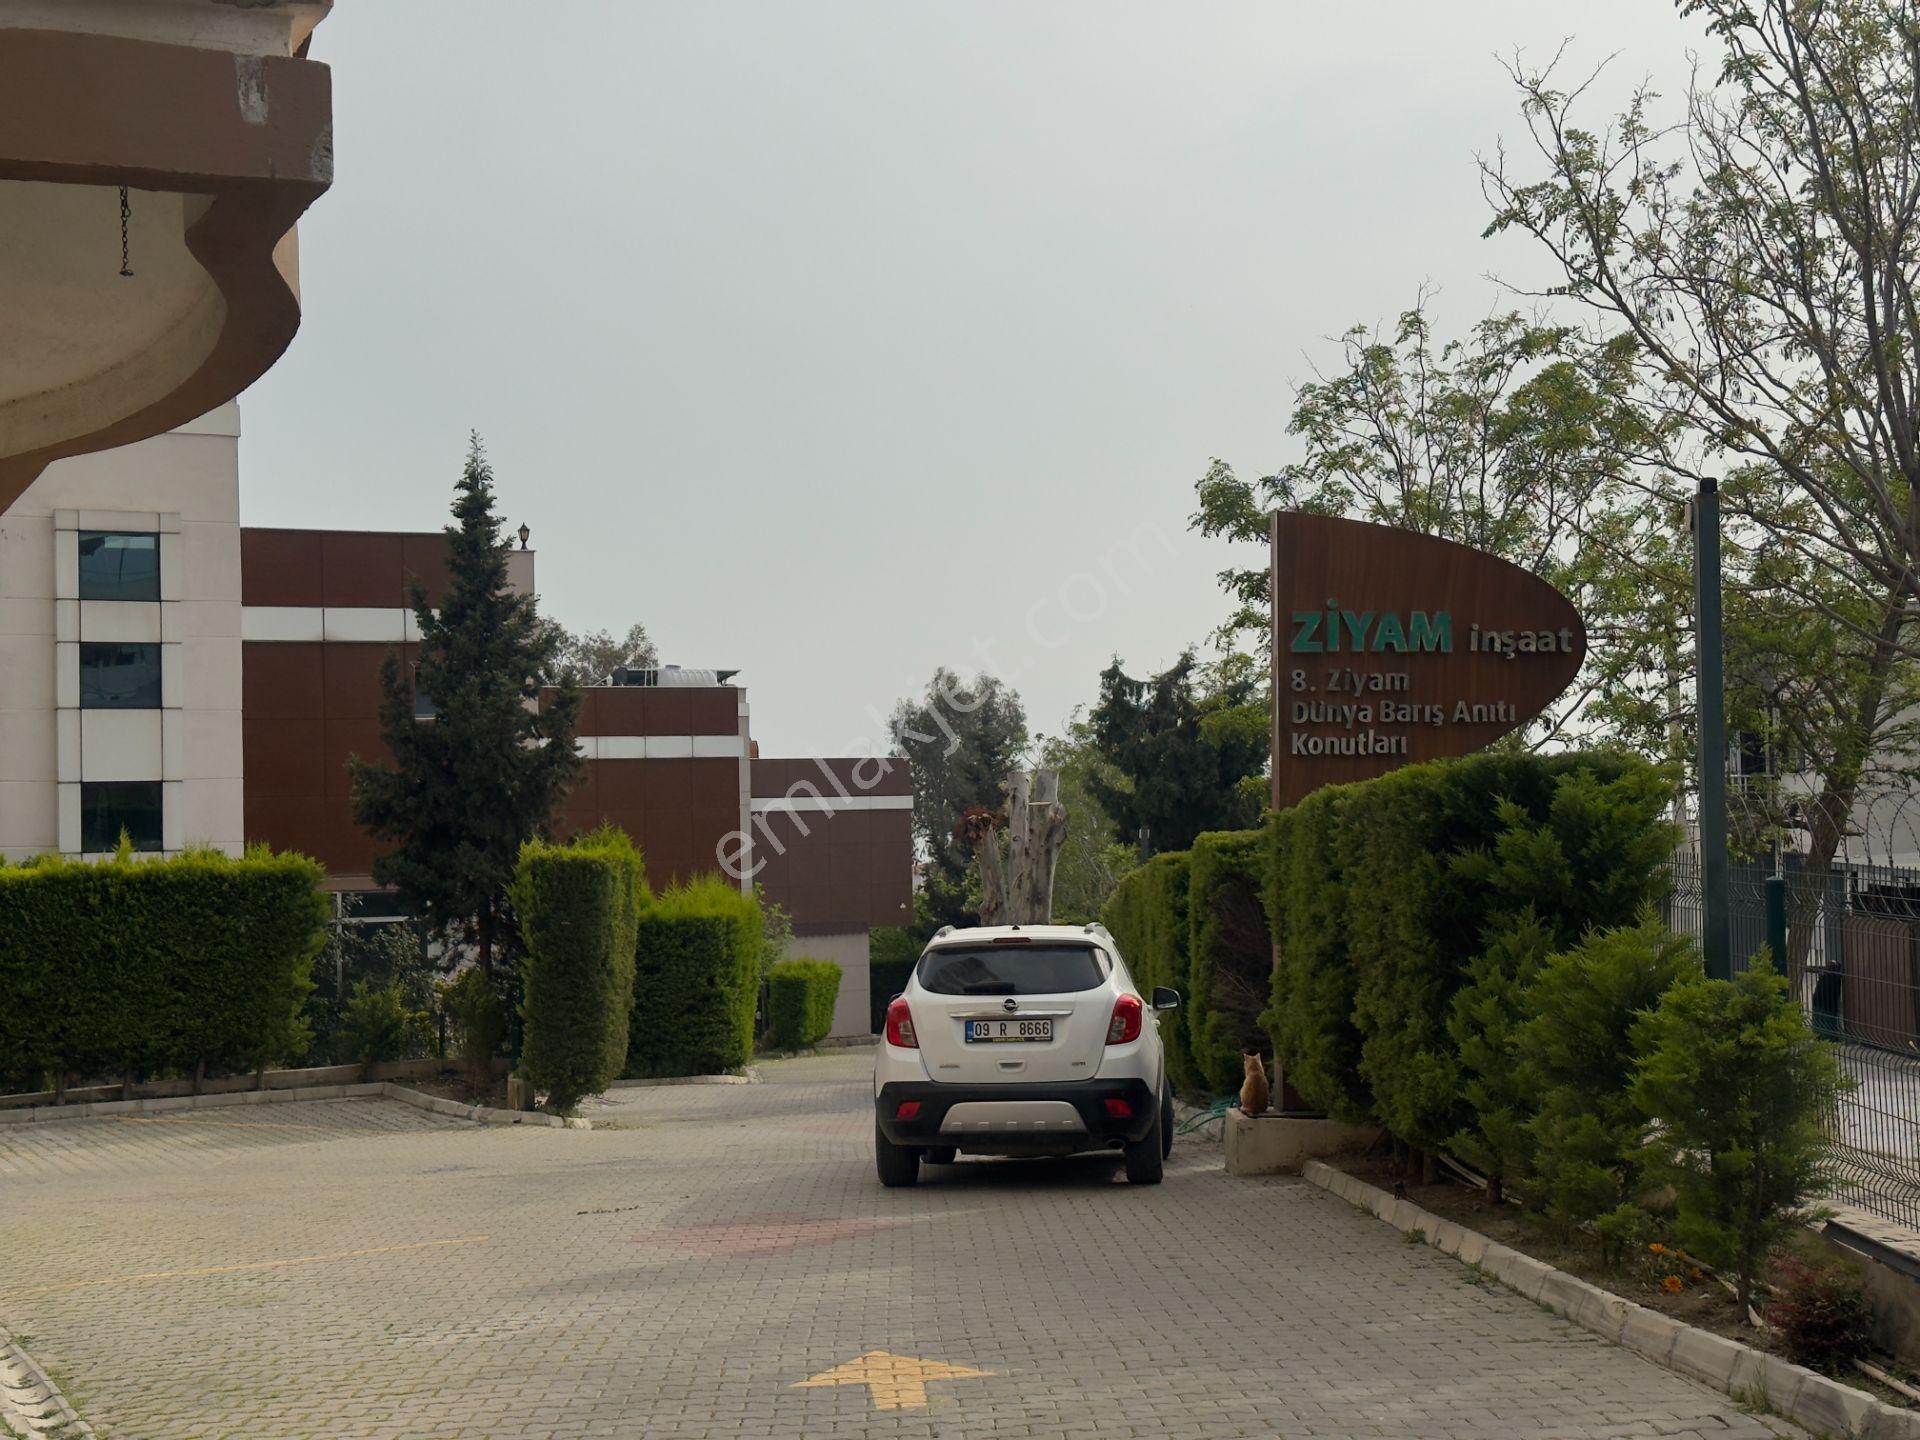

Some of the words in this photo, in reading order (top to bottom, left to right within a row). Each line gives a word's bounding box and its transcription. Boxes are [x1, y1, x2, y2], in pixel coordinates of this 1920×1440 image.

[1291, 598, 1452, 652] ZİYAM
[1470, 624, 1573, 659] inşaat
[1291, 669, 1317, 692] 8.
[1328, 668, 1409, 697] Ziyam
[1291, 701, 1373, 729] Dünya
[1379, 701, 1446, 727] Barış
[1452, 701, 1517, 723] Anıtı
[1291, 729, 1408, 755] Konutları
[975, 1023, 990, 1036] 09
[1000, 1022, 1007, 1036] R
[1019, 1021, 1049, 1035] 8666
